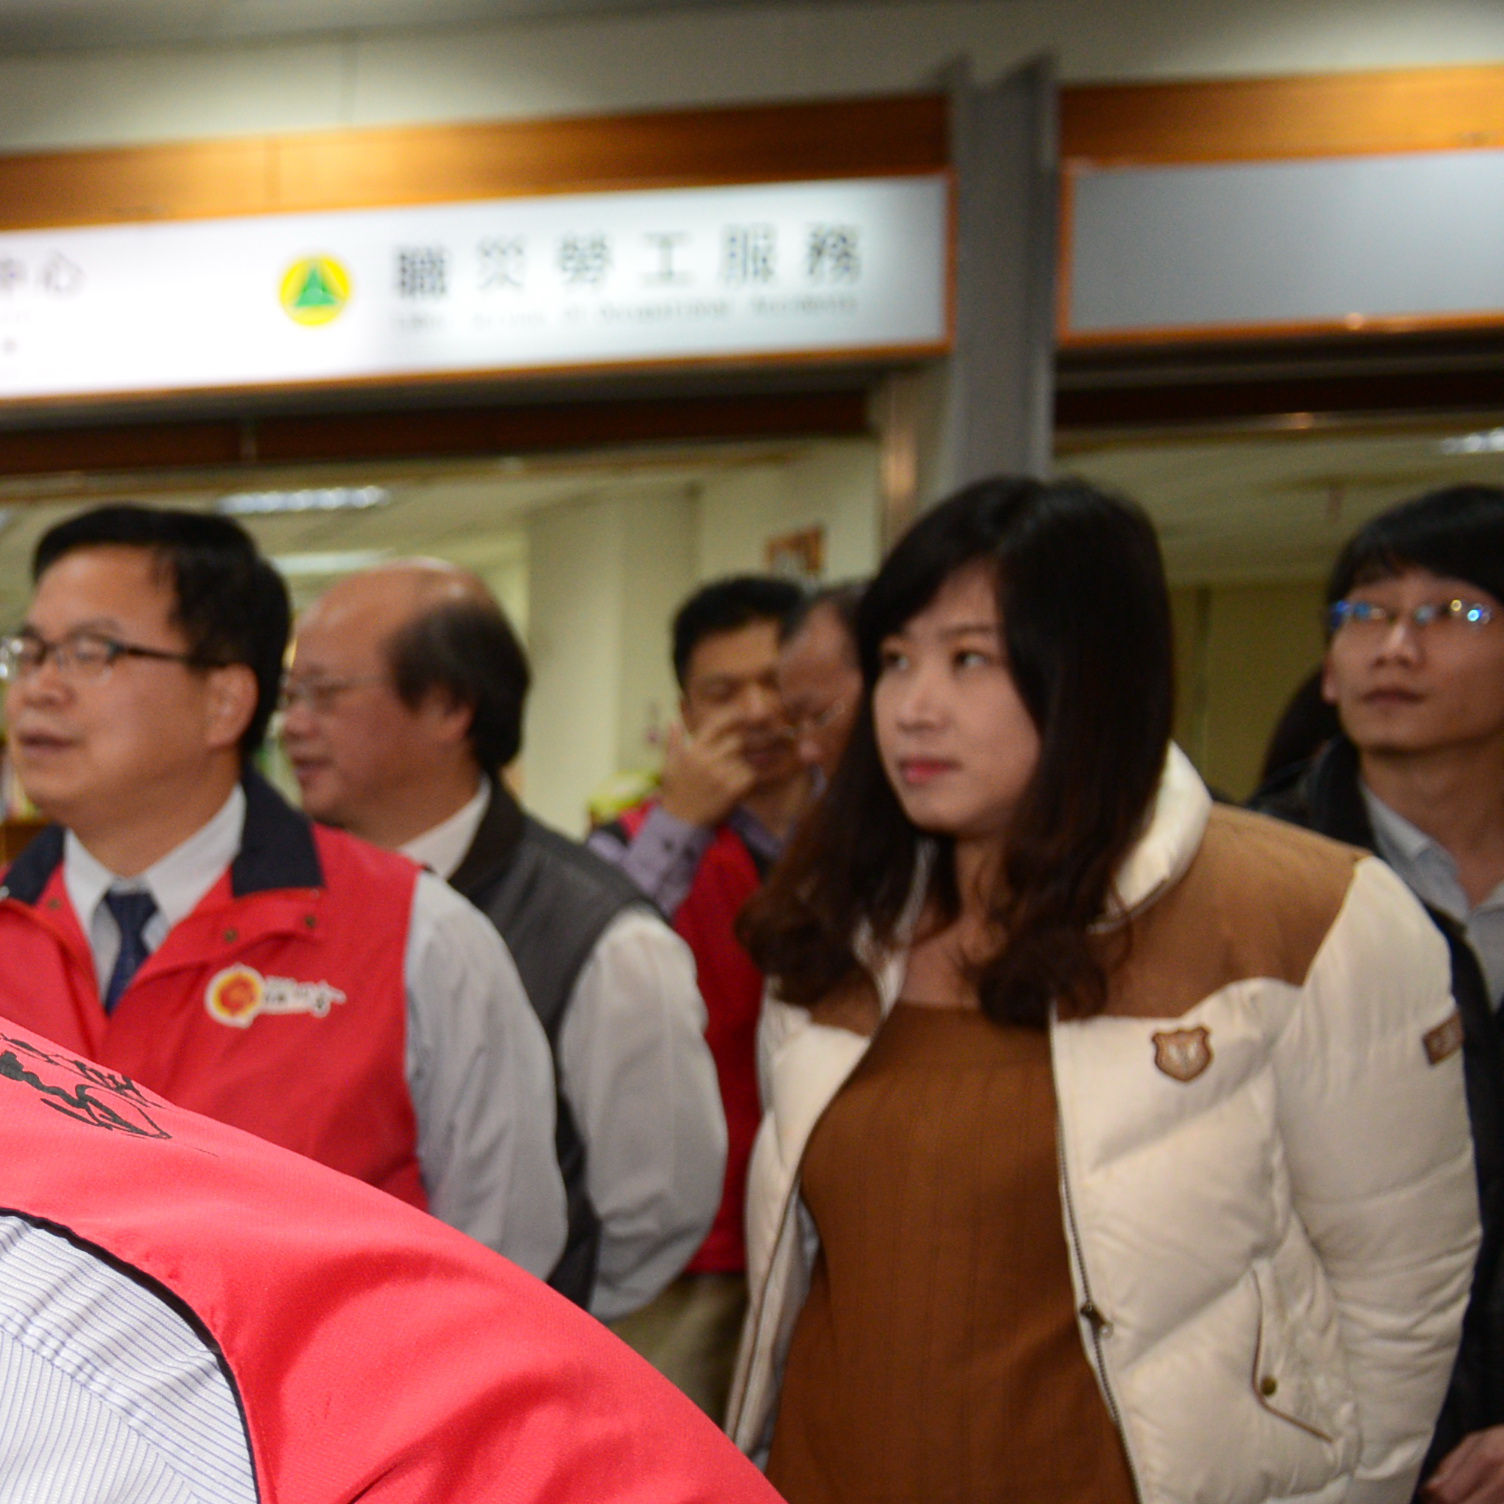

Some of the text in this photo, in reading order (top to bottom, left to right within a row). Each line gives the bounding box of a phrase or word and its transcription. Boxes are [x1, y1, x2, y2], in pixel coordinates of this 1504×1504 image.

[394, 221, 862, 298] 職災勞工服務
